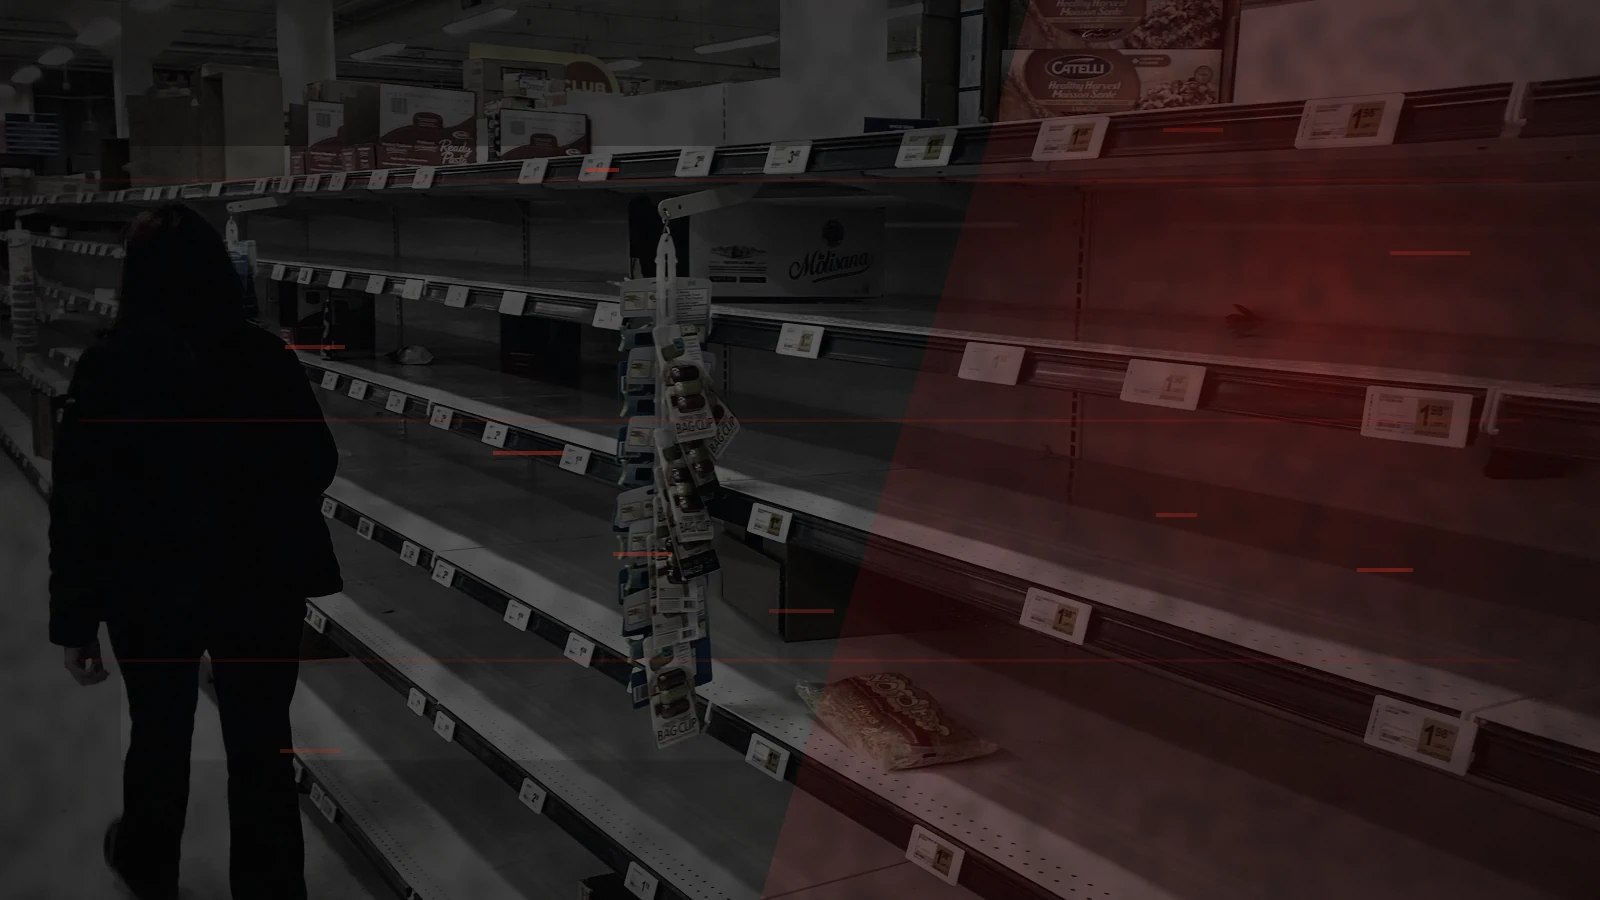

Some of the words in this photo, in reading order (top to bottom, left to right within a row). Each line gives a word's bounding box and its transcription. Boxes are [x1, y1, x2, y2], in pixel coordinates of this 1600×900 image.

[1051, 61, 1105, 75] CATELLI
[1048, 80, 1084, 92] Healthy
[1084, 80, 1122, 91] Harvest
[438, 138, 473, 158] Ready
[657, 725, 677, 742] BAG
